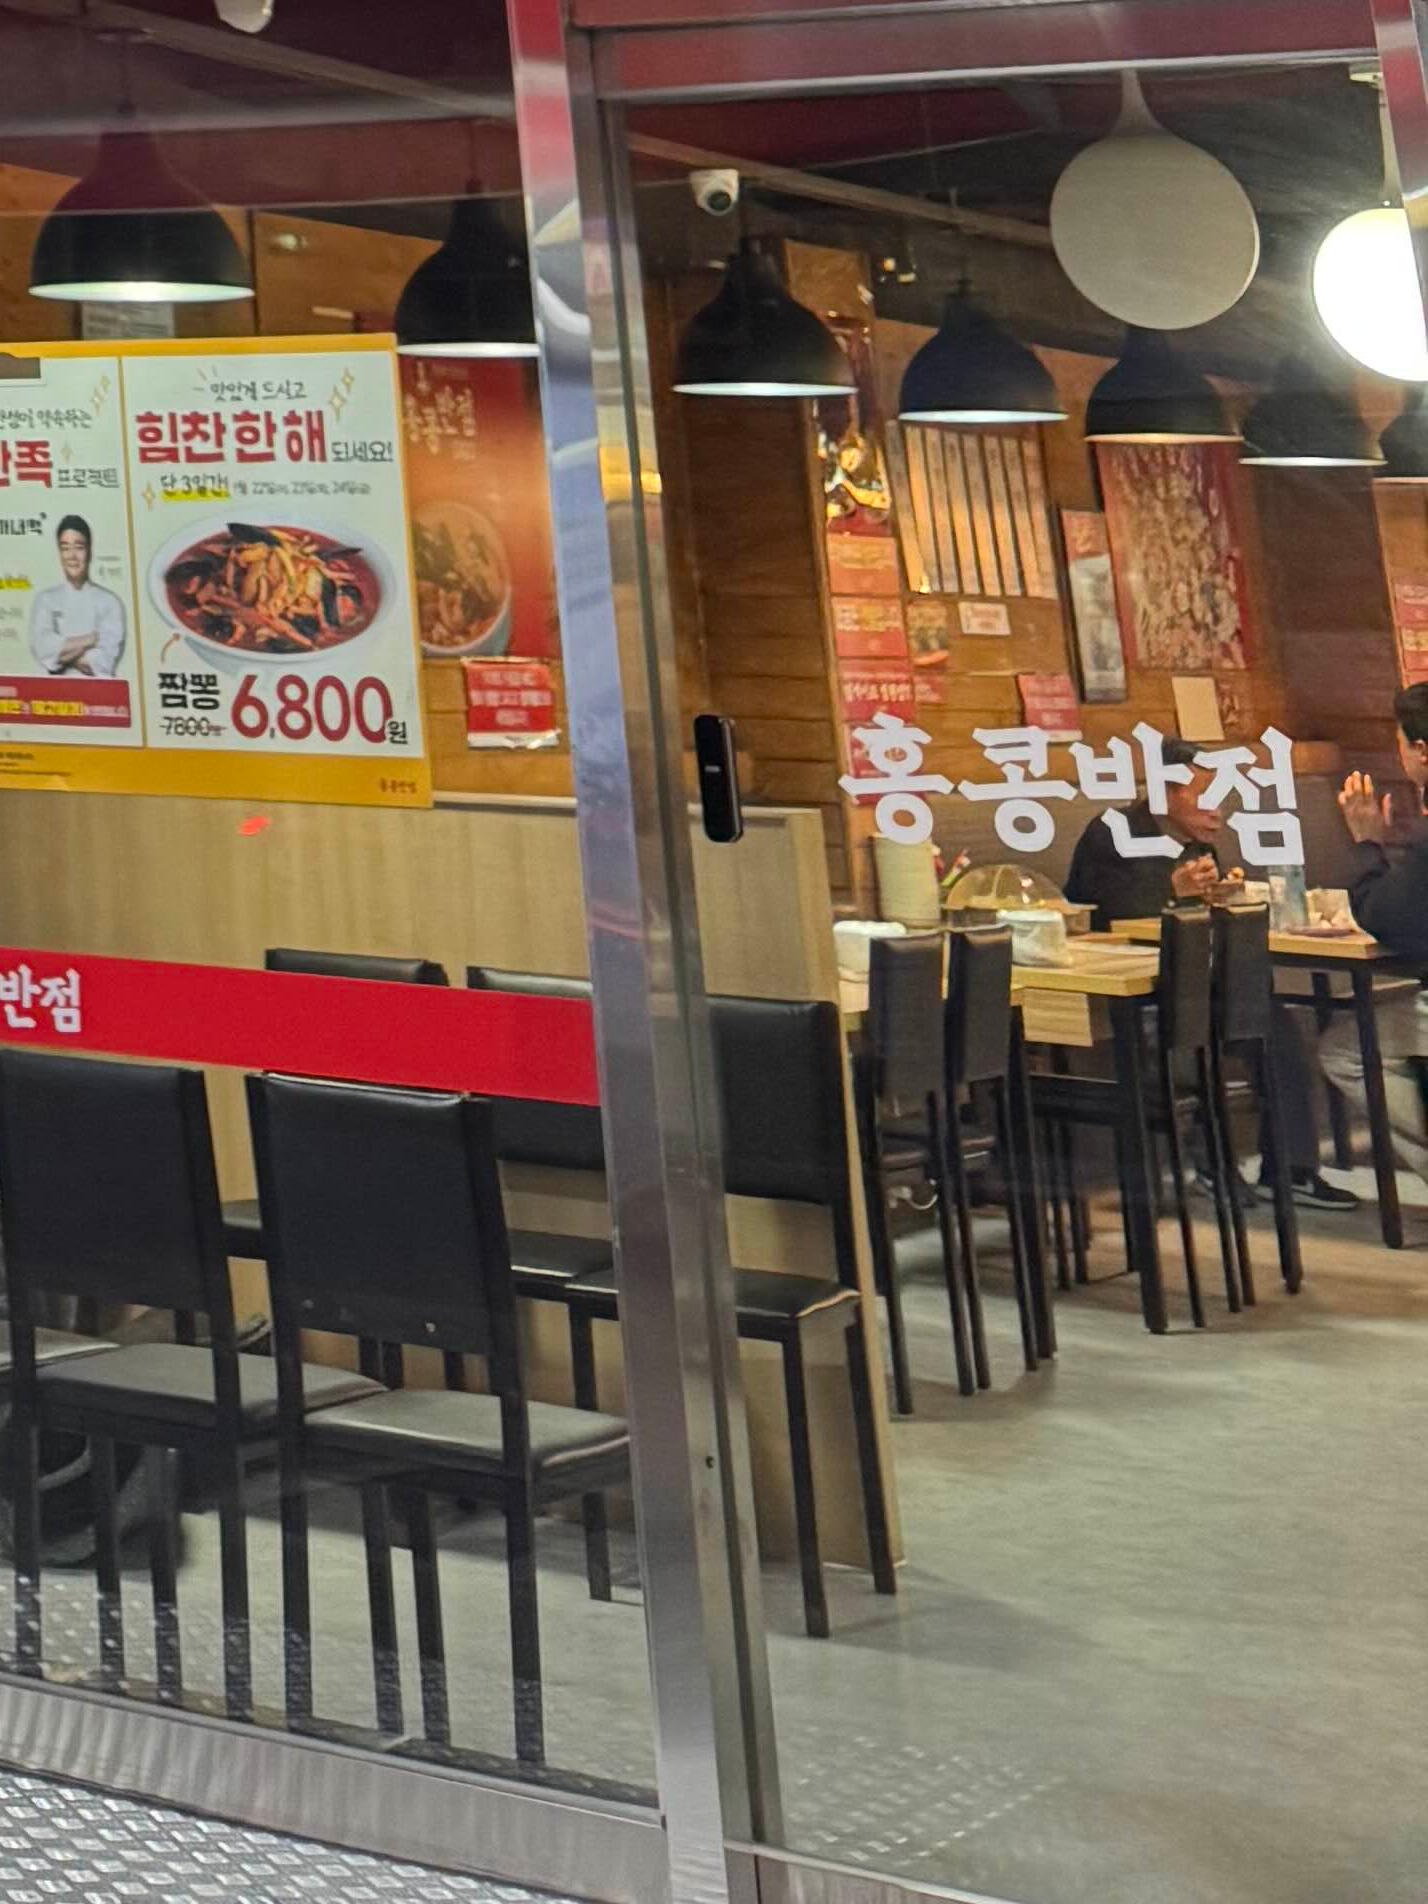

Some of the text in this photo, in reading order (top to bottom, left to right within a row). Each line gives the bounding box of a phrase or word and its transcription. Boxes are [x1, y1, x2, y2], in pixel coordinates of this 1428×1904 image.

[262, 379, 308, 400] 드시고
[136, 410, 227, 464] 힘찬
[57, 467, 120, 489] 프로젝트
[158, 671, 221, 711] 짬뽕
[837, 710, 1305, 867] 홍콩반점
